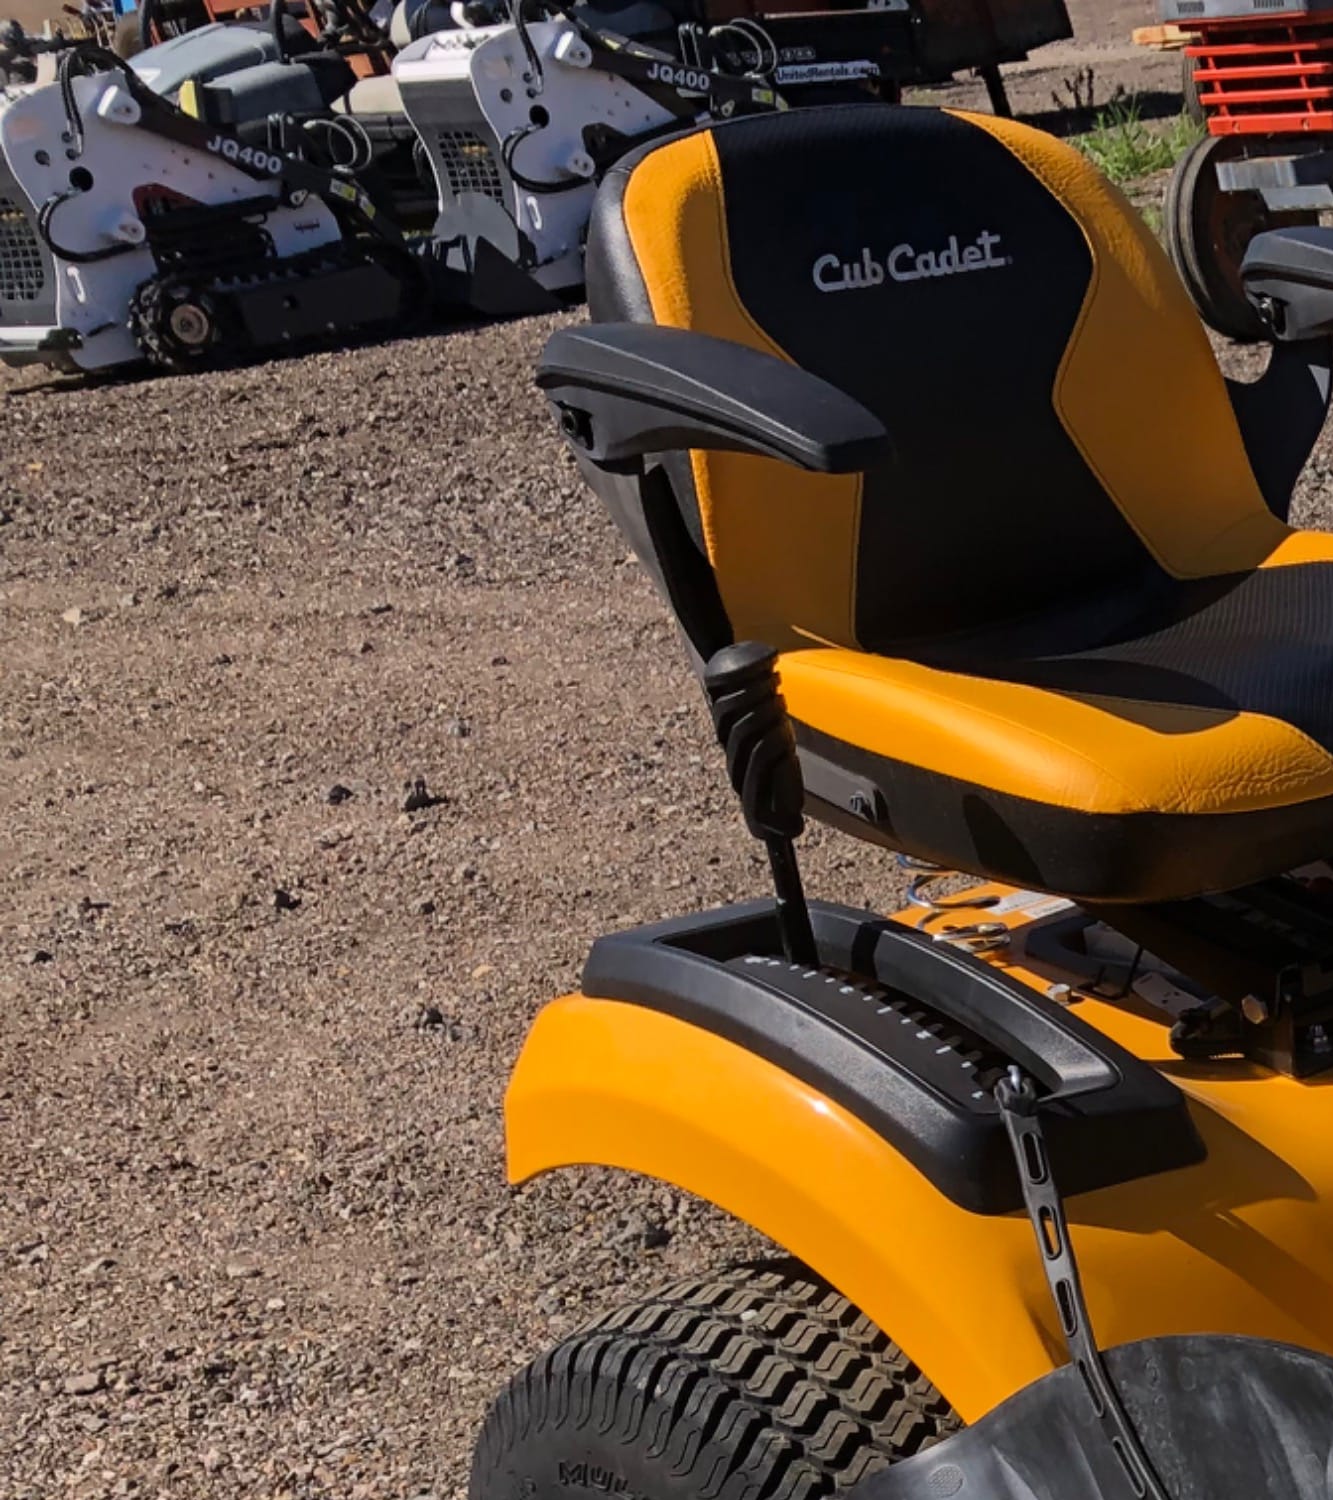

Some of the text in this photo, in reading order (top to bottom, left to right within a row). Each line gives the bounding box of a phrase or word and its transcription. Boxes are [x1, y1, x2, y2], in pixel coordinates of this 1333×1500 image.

[647, 62, 710, 90] JQ400
[206, 135, 282, 173] JQ400
[812, 230, 1006, 292] Cub Cadet
